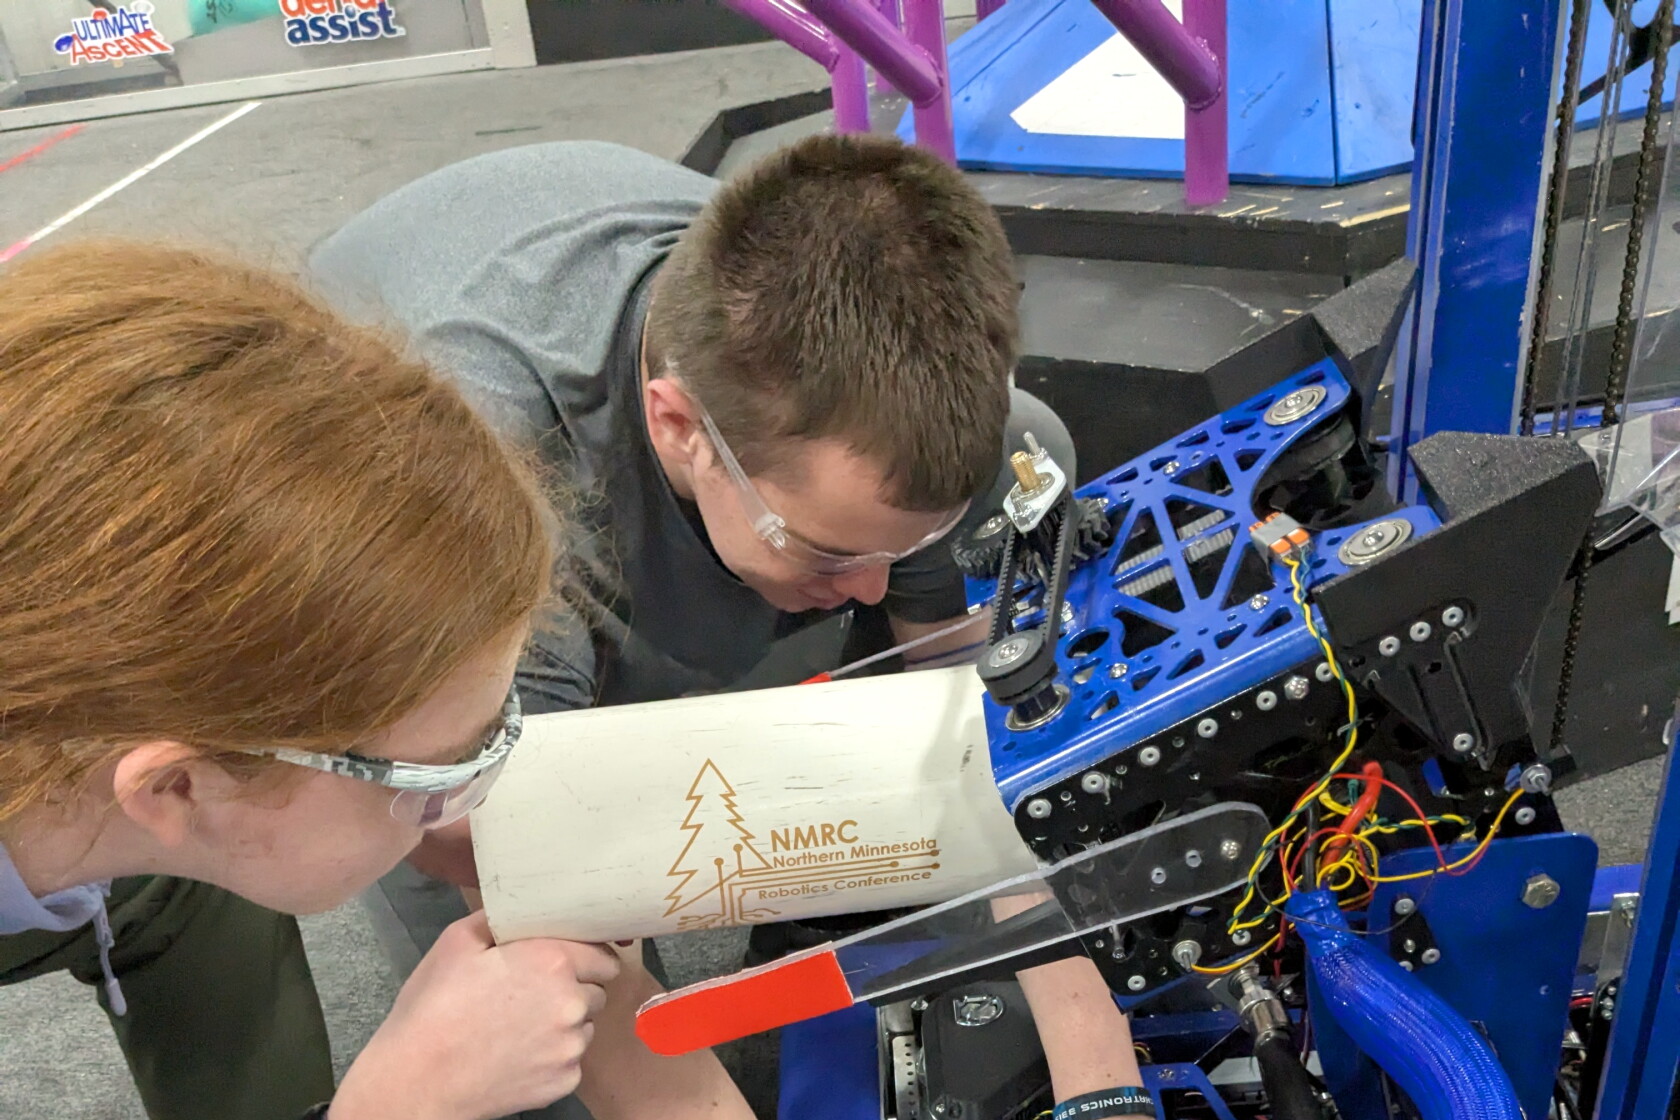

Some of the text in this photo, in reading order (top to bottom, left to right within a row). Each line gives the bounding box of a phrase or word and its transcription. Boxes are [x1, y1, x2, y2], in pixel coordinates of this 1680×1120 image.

[73, 8, 152, 41] ULTIMATE
[286, 2, 398, 44] assist
[771, 820, 858, 852] NMRC
[773, 837, 937, 869] Northern Minnesota
[758, 871, 932, 900] Robotics Conference
